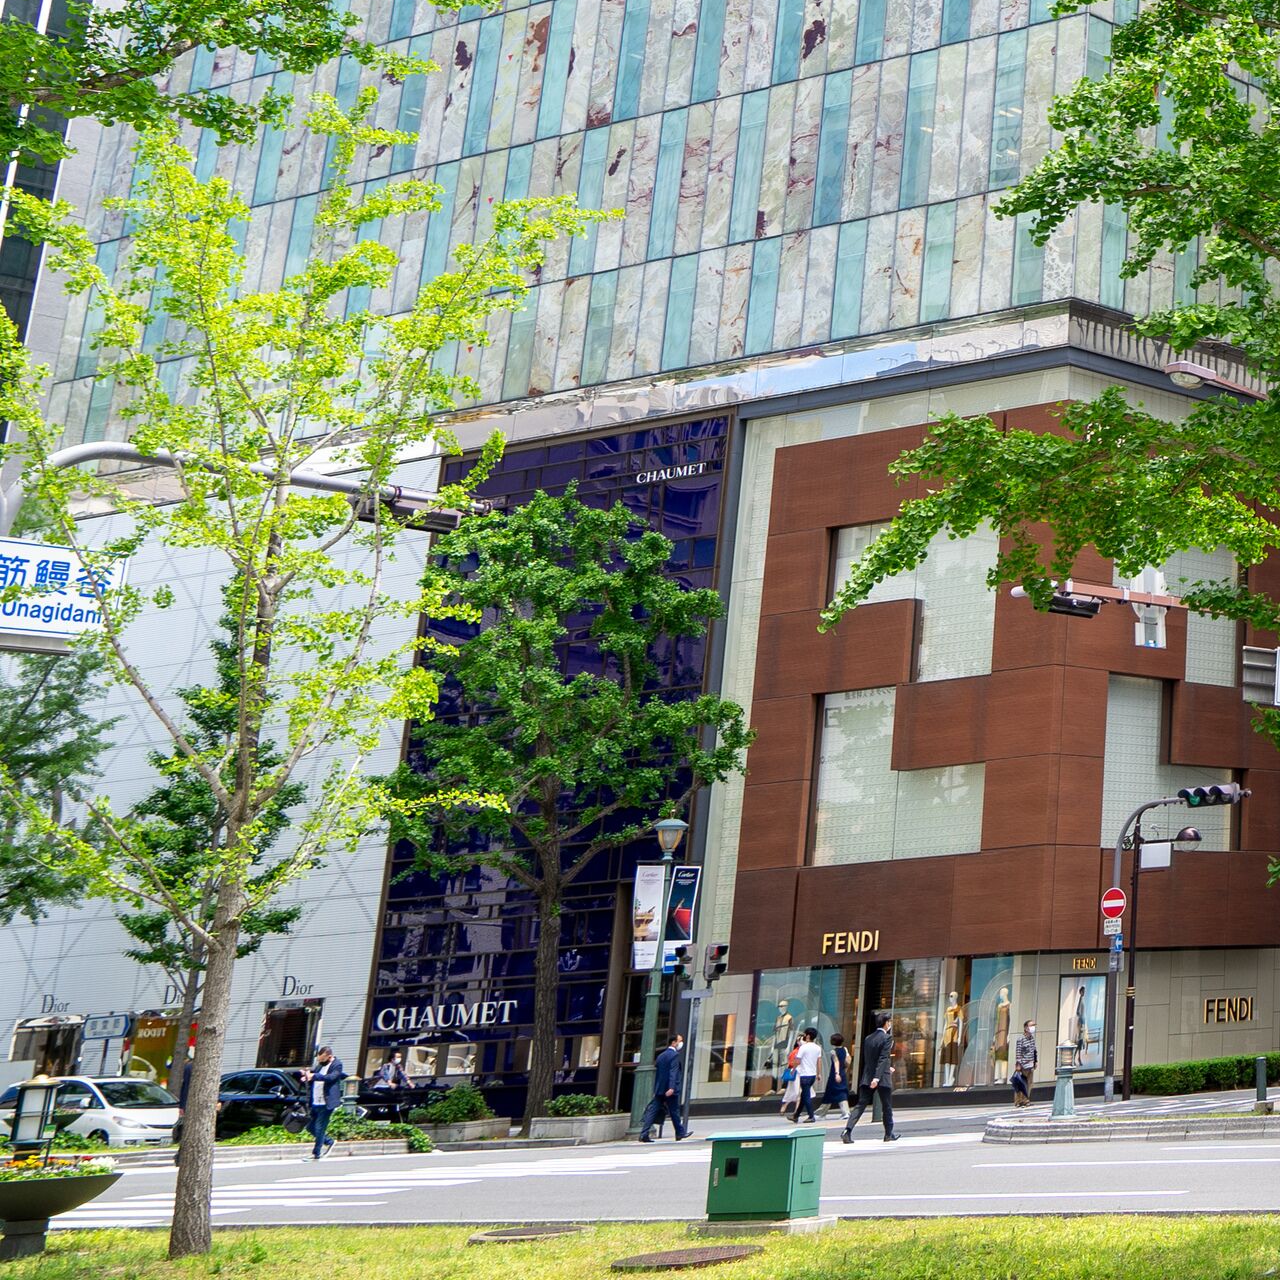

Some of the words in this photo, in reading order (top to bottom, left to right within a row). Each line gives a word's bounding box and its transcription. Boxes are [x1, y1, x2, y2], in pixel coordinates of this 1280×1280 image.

[636, 463, 707, 483] CHAUMET
[0, 600, 102, 624] Unagidani
[822, 930, 880, 955] FENDI
[1073, 957, 1097, 970] FENDI
[163, 984, 186, 1005] Dio
[281, 975, 314, 996] Dior
[41, 994, 70, 1014] Dior
[1203, 996, 1253, 1024] FENDI
[377, 1000, 518, 1031] CHAUMET
